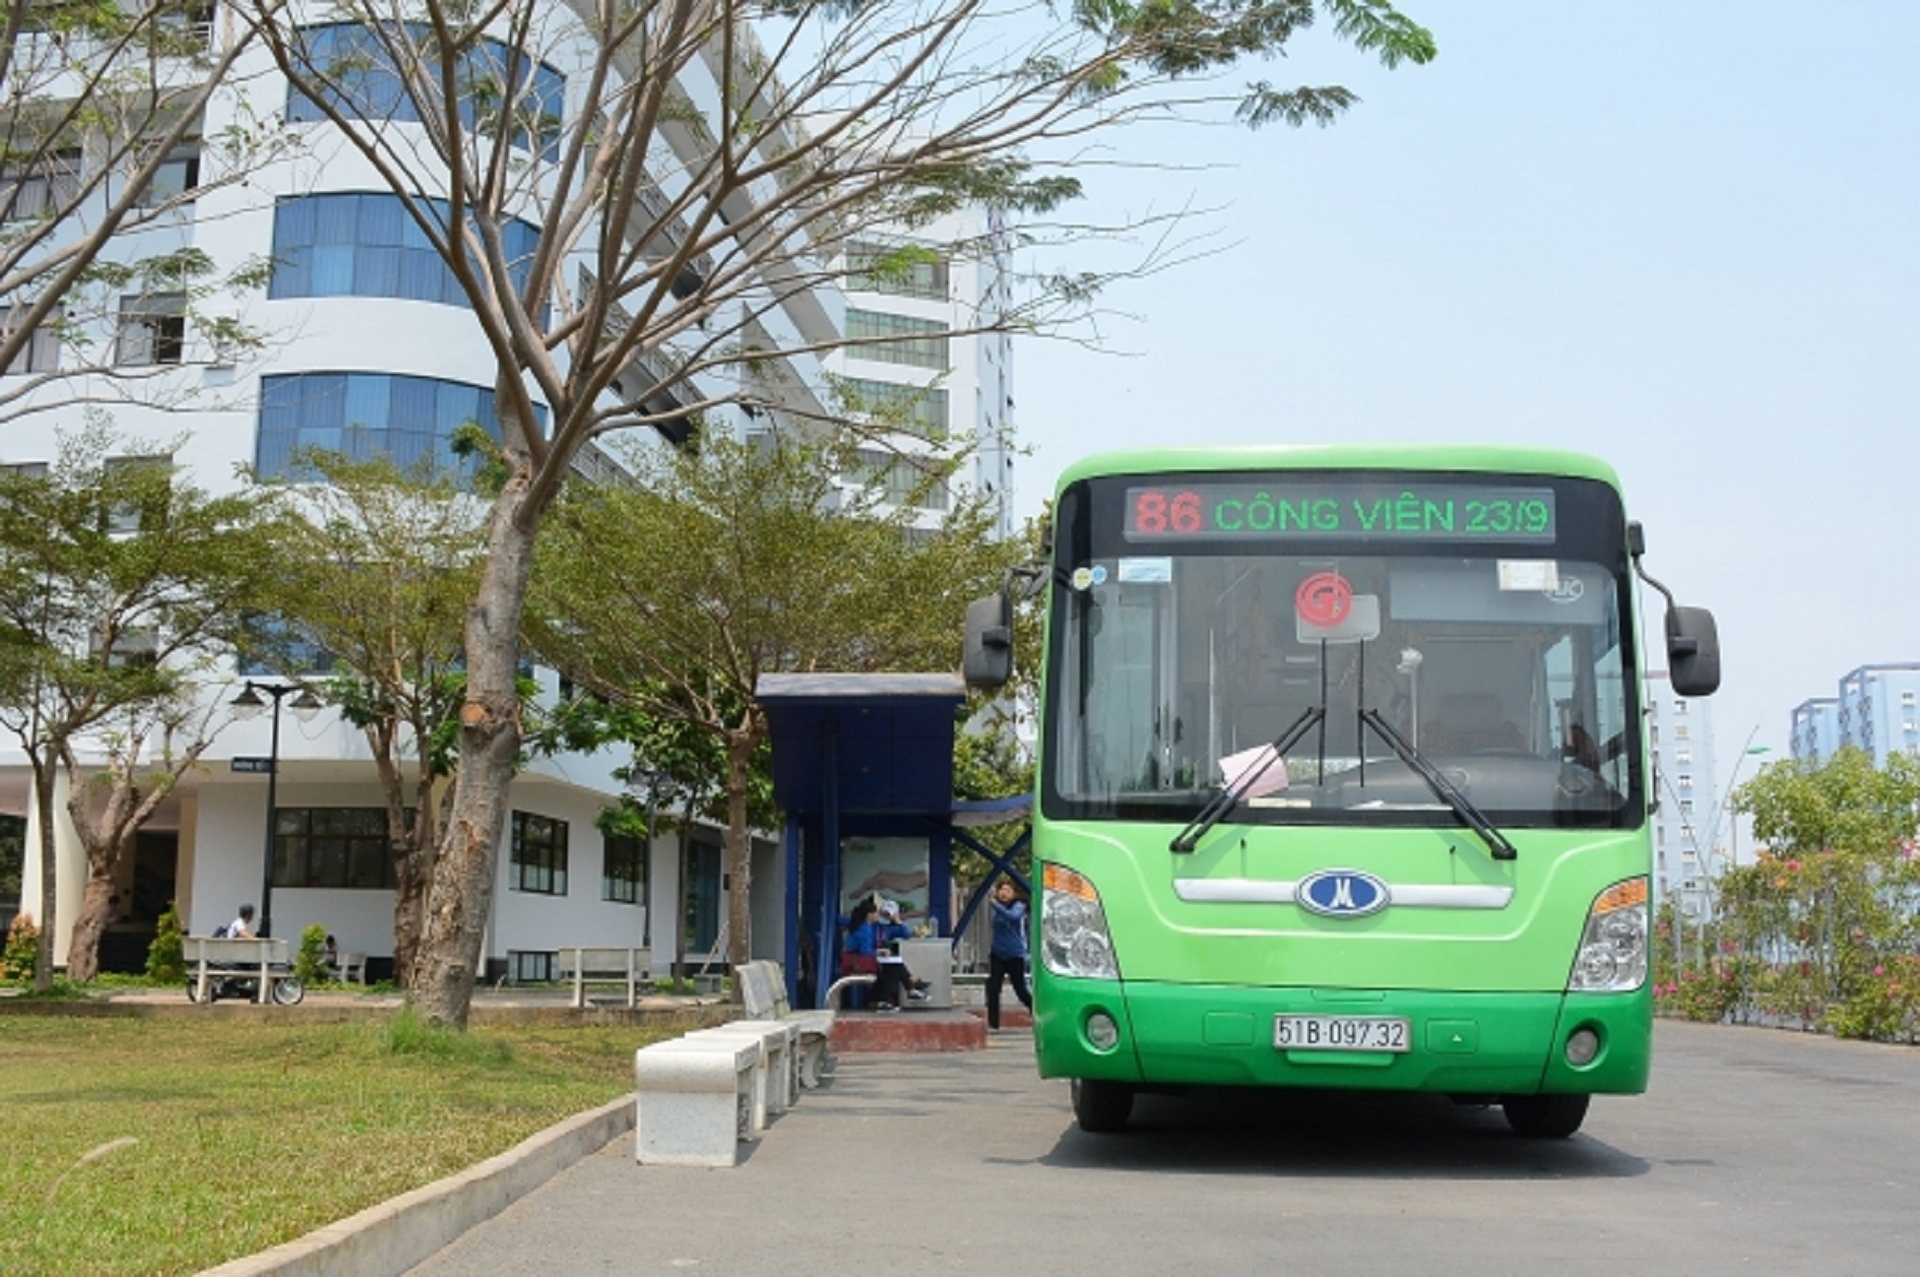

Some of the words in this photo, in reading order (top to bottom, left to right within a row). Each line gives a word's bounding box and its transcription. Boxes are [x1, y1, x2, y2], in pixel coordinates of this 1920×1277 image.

[1136, 490, 1203, 534] 86
[1214, 491, 1340, 531] CÔNG
[1353, 491, 1454, 531] VIÊN
[1465, 499, 1548, 532] 23/9
